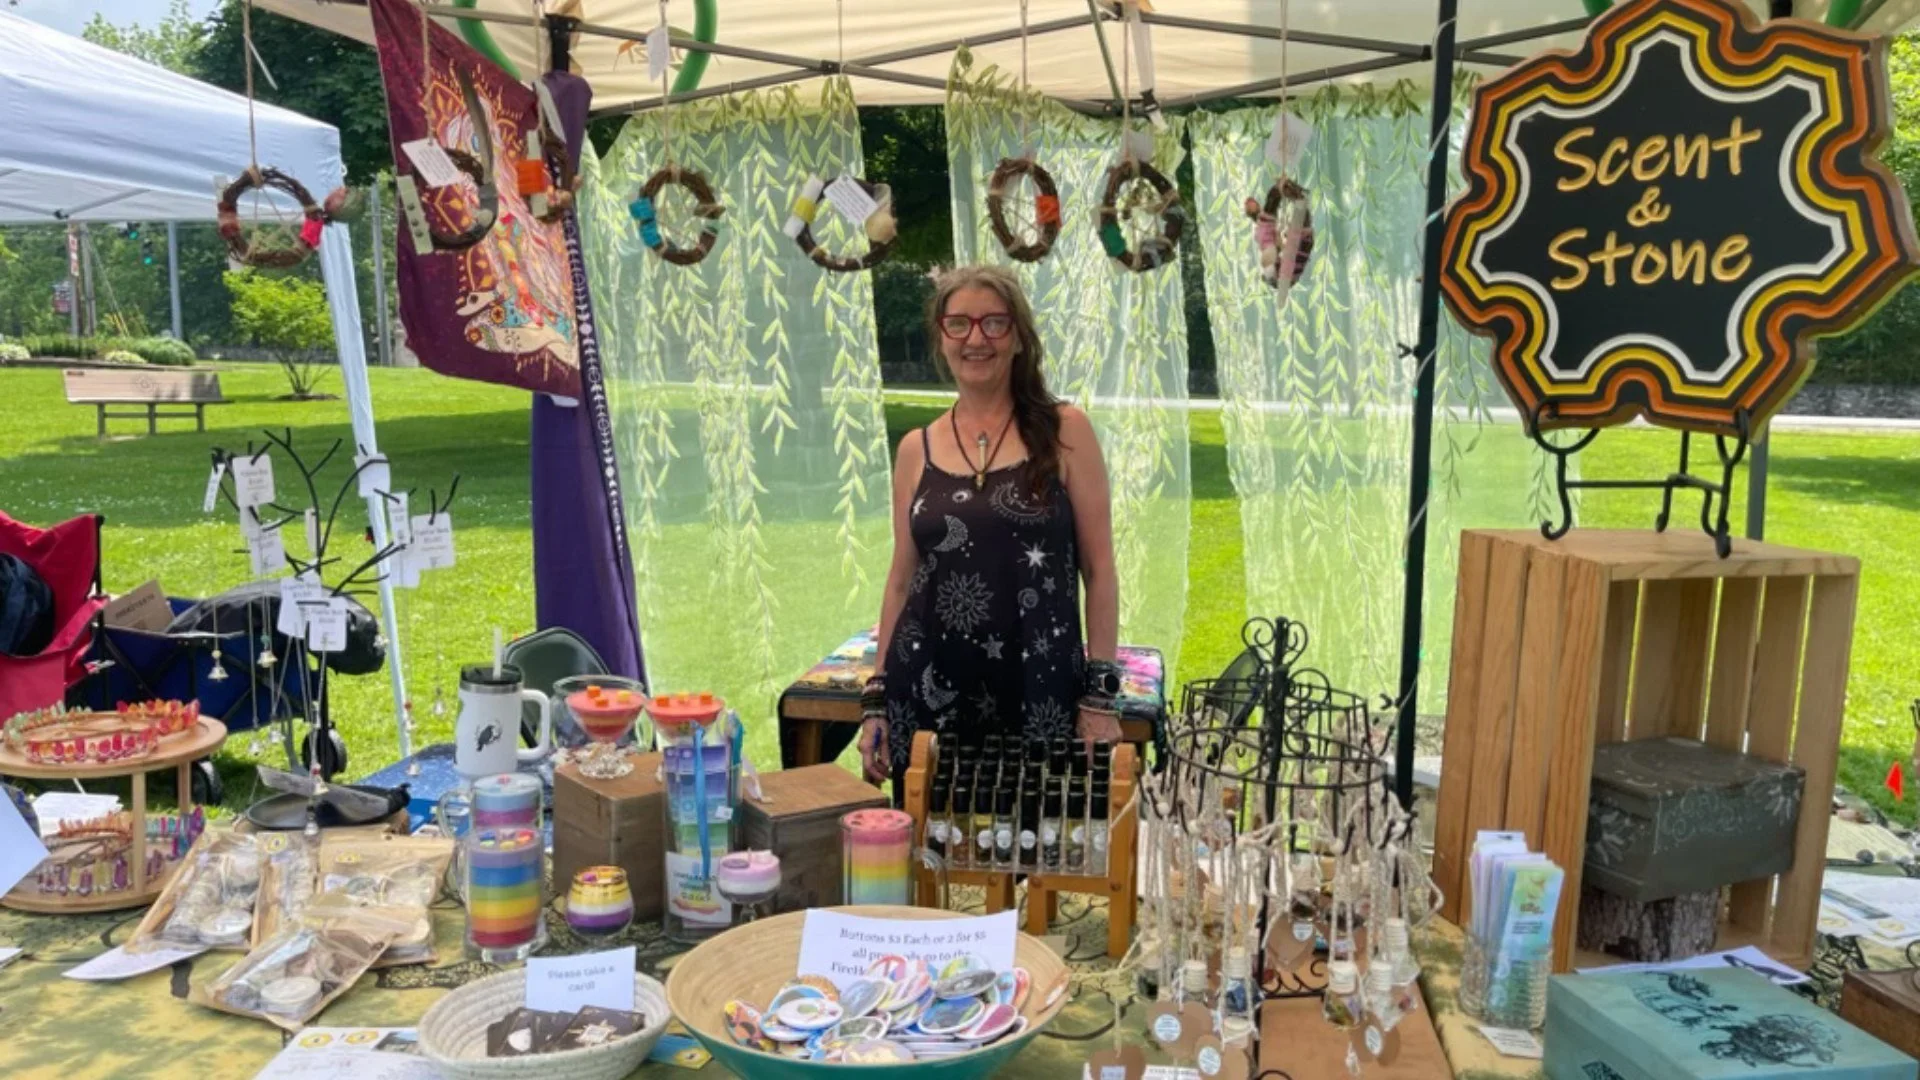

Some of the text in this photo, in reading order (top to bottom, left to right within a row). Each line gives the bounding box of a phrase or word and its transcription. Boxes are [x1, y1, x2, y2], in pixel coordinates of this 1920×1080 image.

[1553, 115, 1762, 193] Scent
[1627, 186, 1671, 227] &
[1548, 228, 1754, 291] Stone
[852, 947, 867, 958] all
[939, 952, 951, 961] to
[903, 932, 931, 944] Each
[933, 936, 946, 944] or
[957, 931, 971, 942] for
